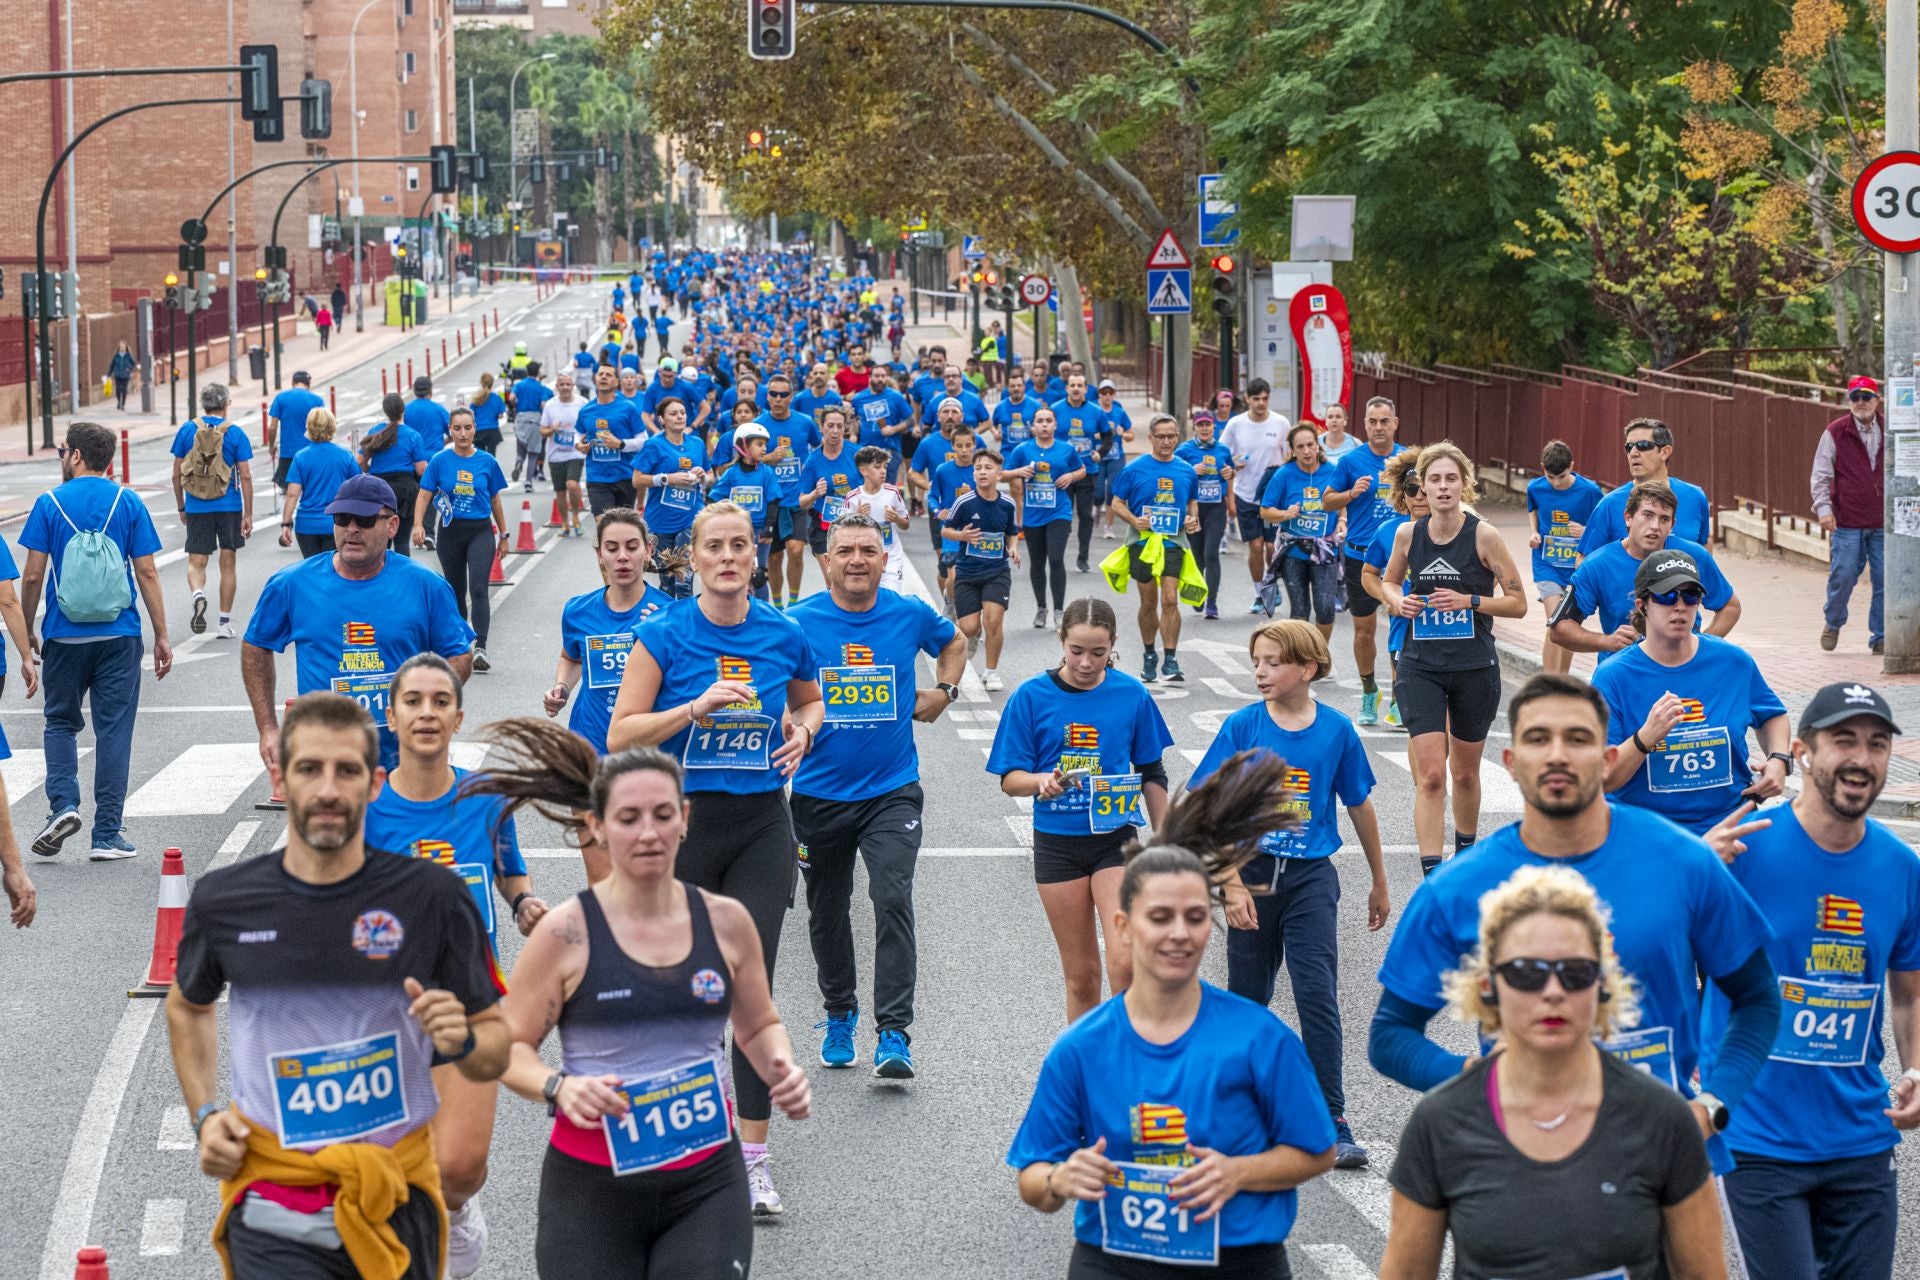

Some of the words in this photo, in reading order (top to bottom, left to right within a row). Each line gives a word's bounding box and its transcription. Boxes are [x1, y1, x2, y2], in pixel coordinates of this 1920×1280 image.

[1874, 186, 1920, 218] 30
[1027, 284, 1045, 295] 30
[775, 465, 795, 475] 073
[670, 489, 691, 500] 301
[733, 494, 760, 504] 2691
[1029, 491, 1053, 500] 1135
[1297, 519, 1320, 530] 002
[1656, 559, 1697, 573] adidas
[1418, 609, 1468, 626] 1184
[346, 660, 385, 671] VALENCIA
[828, 684, 890, 705] 2936
[698, 731, 763, 751] 1146
[1701, 738, 1727, 748] VALENCIA
[1664, 750, 1716, 773] 763
[1813, 956, 1866, 973] VALENCIA
[1793, 1009, 1856, 1041] 041
[287, 1065, 394, 1115] 4040
[618, 1089, 718, 1144] 1165
[1121, 1194, 1188, 1234] 621
